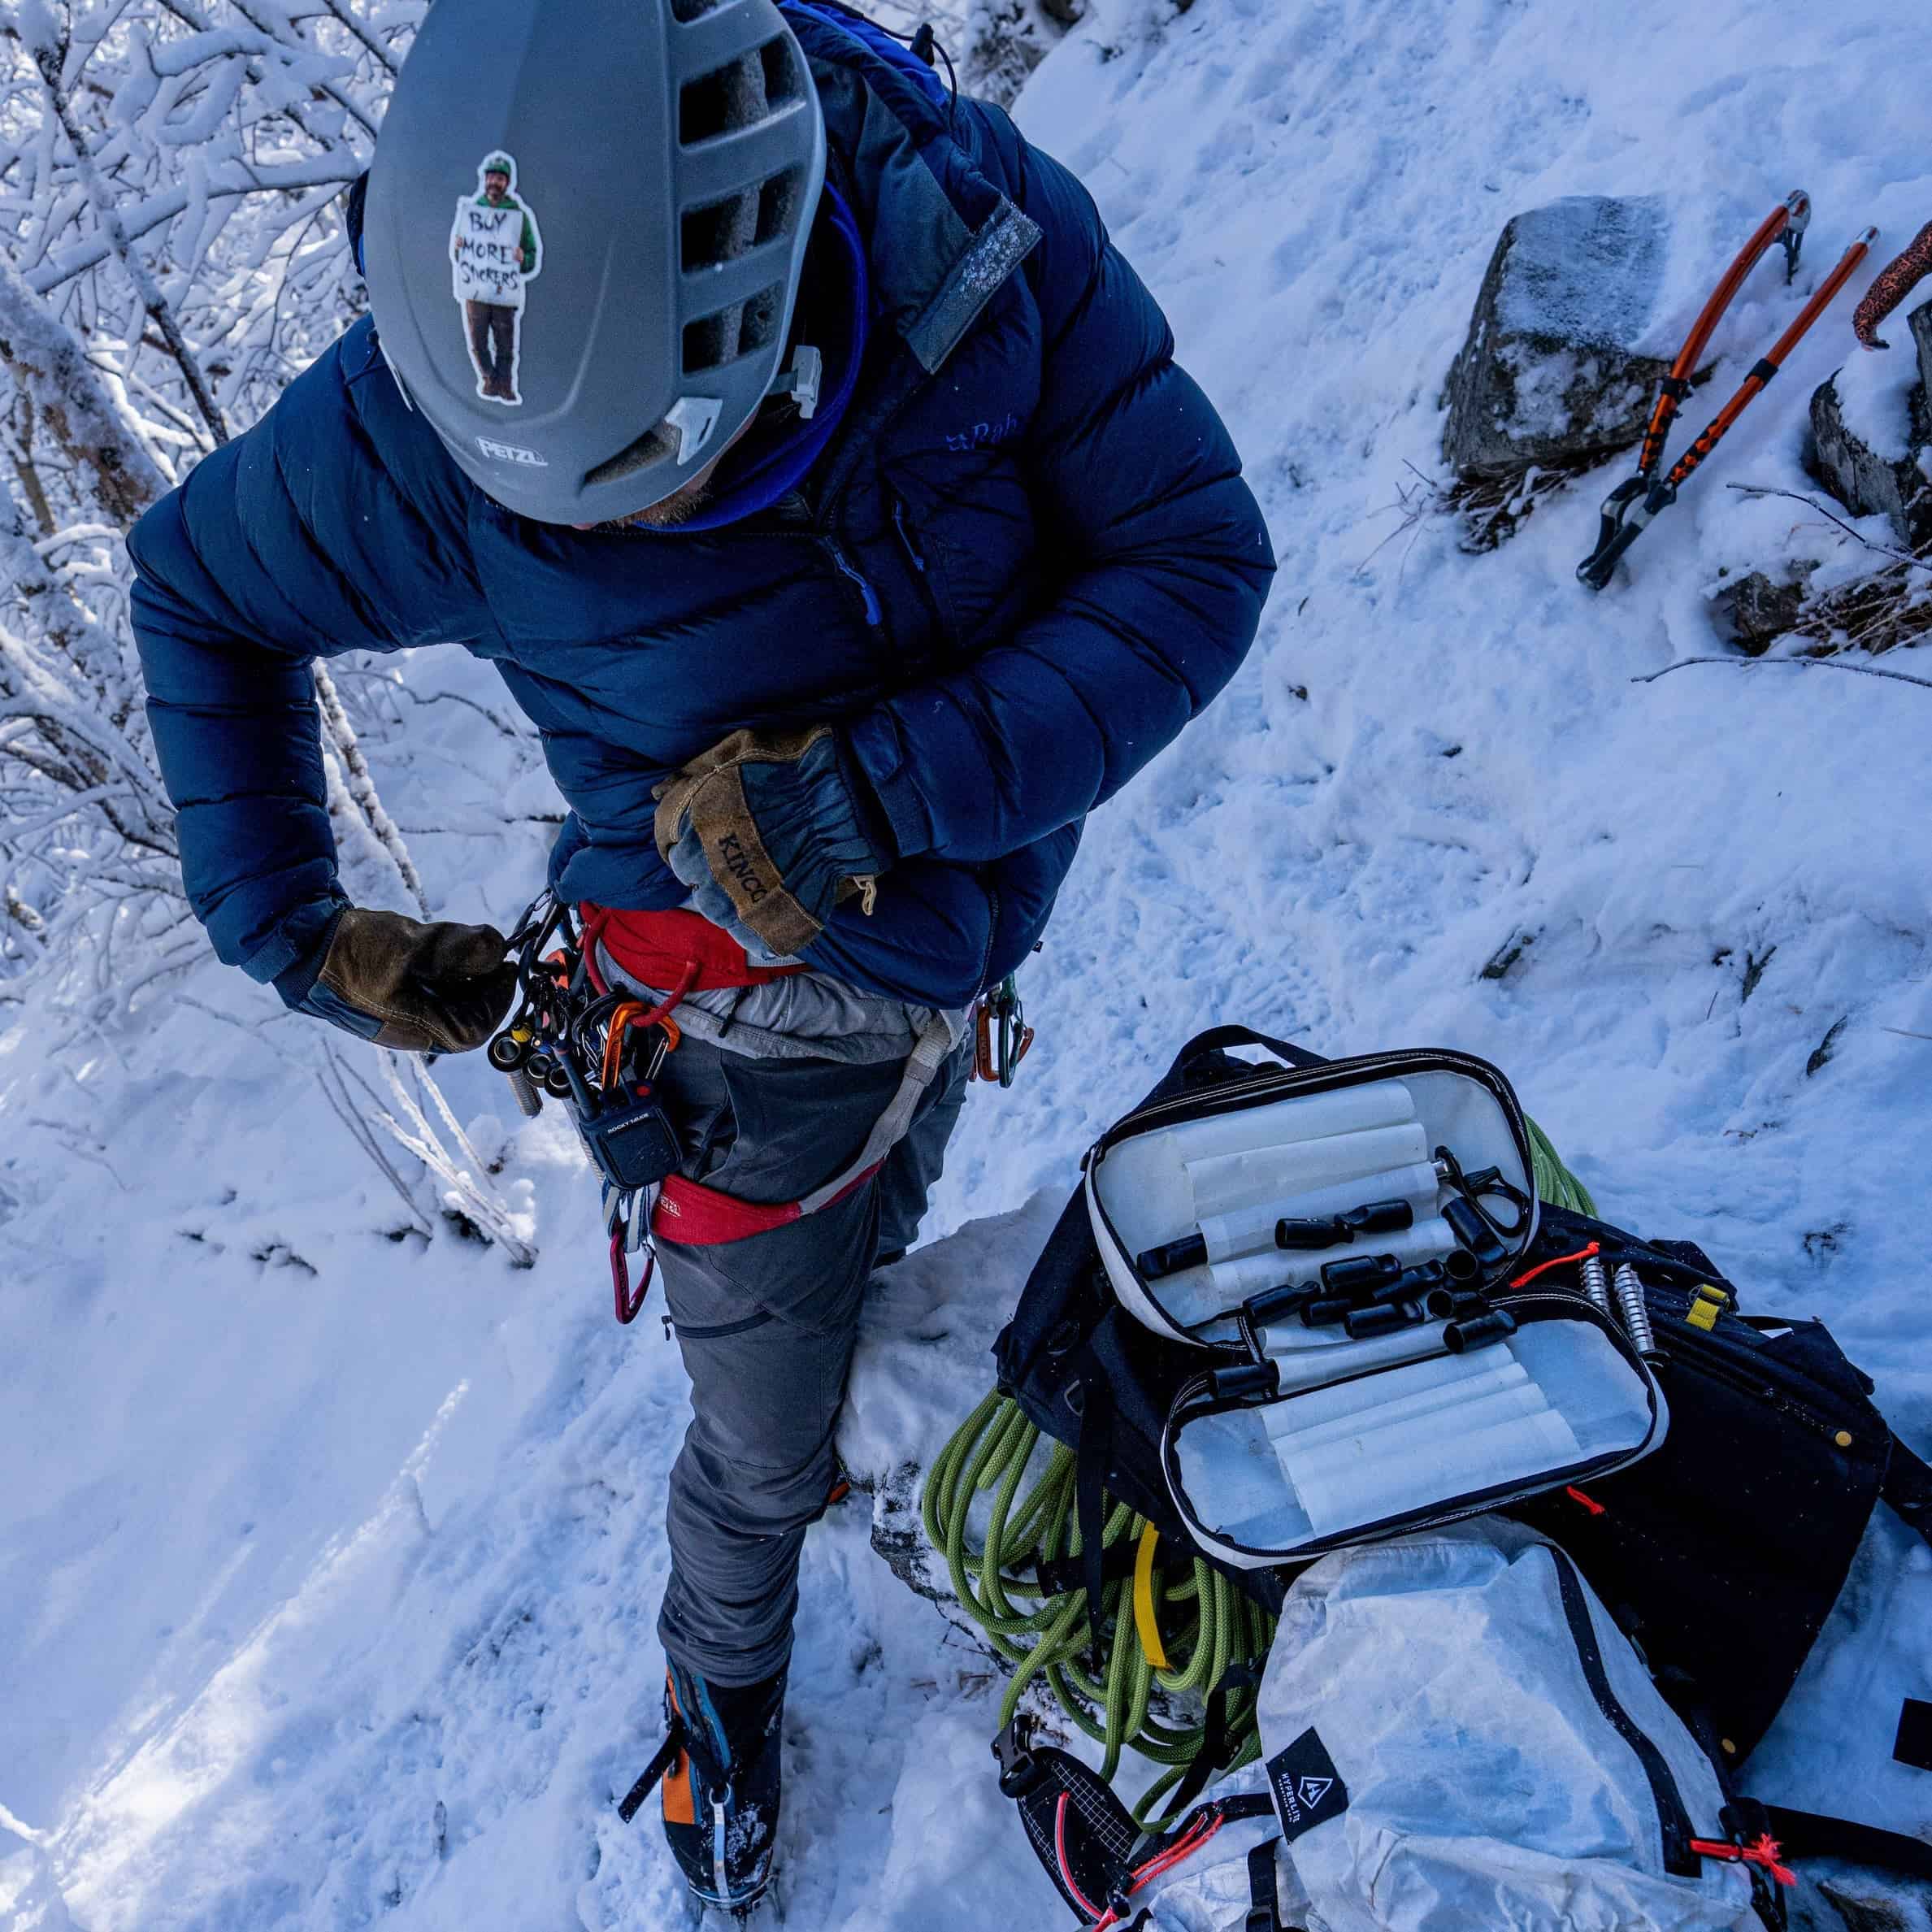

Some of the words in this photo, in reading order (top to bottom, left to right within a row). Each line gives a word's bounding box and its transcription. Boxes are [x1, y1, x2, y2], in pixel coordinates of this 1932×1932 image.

[468, 211, 507, 233] BUY
[462, 237, 514, 265] MORE
[477, 436, 549, 468] PETZL
